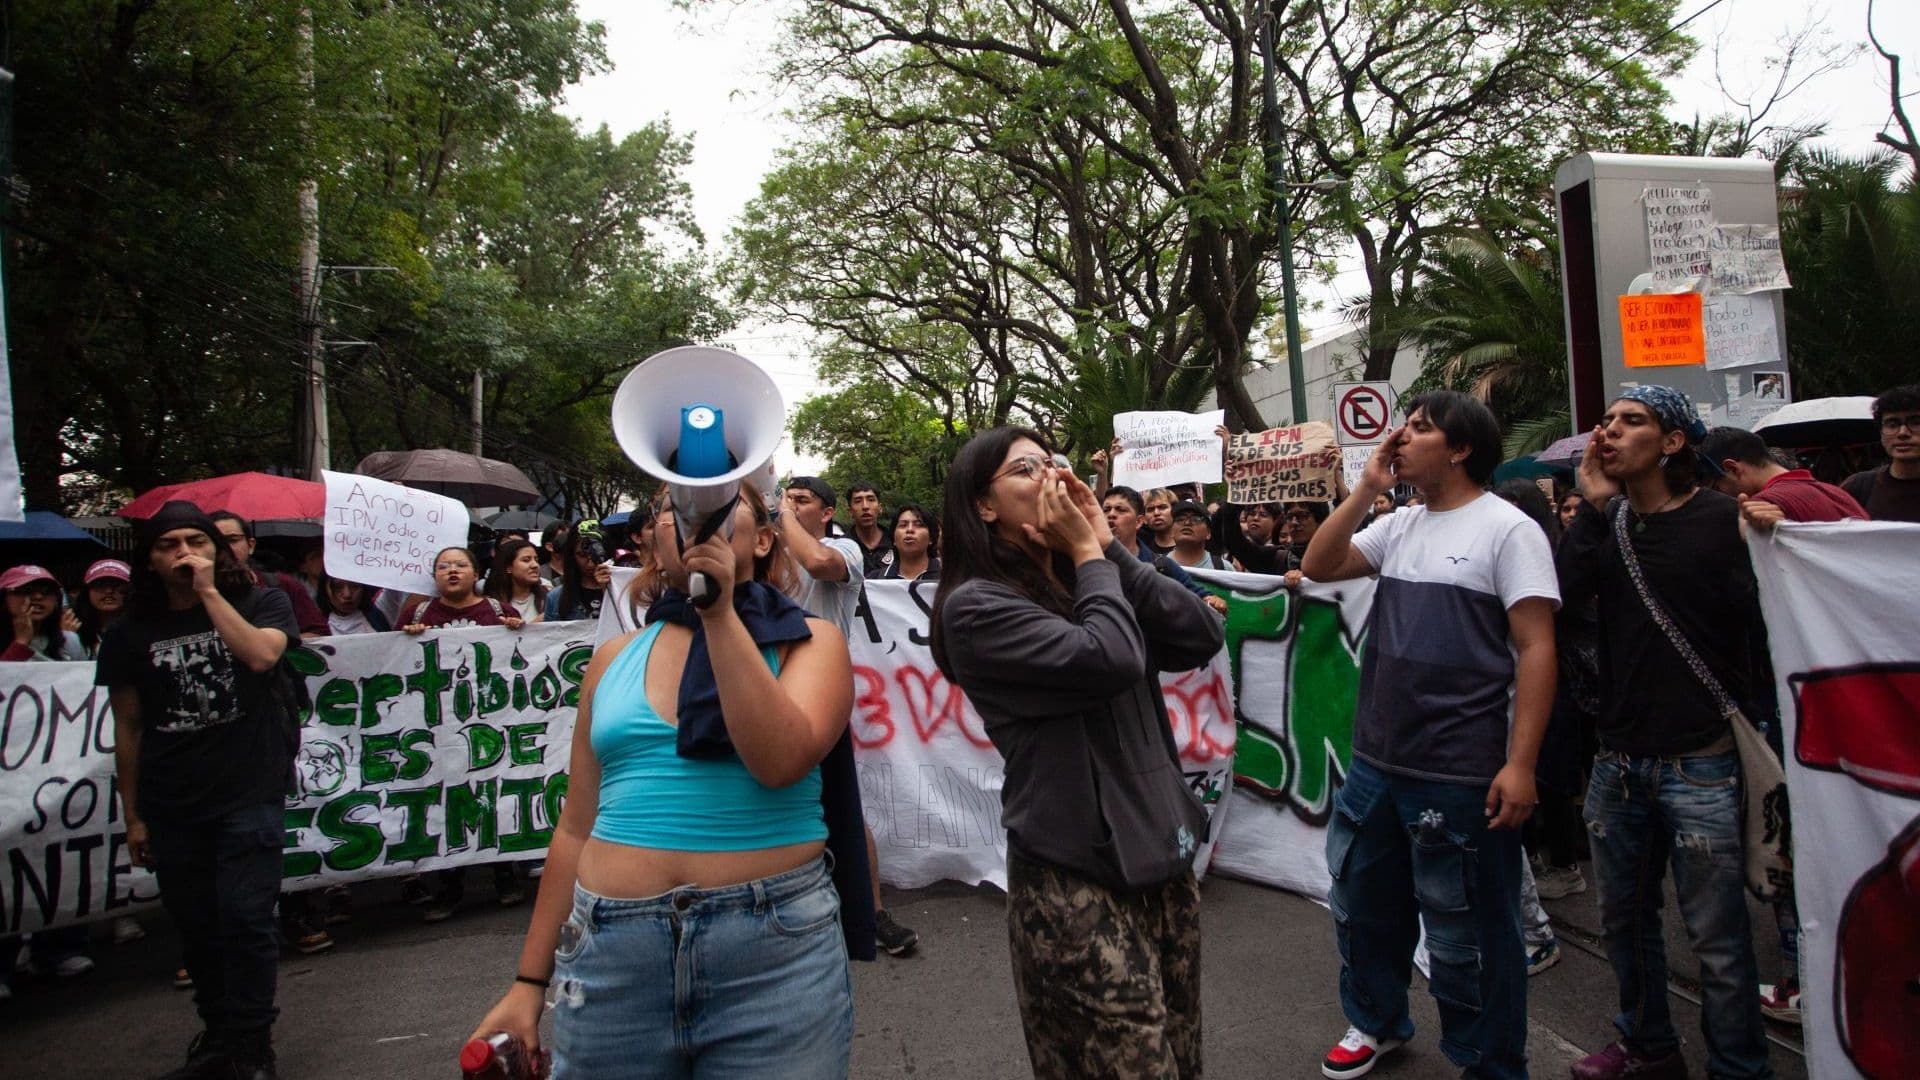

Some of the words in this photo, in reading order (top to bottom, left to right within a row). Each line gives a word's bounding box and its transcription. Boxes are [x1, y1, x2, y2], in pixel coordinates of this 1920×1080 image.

[1703, 299, 1737, 322] Todo
[1230, 434, 1255, 449] EL
[1258, 426, 1302, 446] IPN
[1247, 445, 1265, 460] DE
[1270, 441, 1304, 457] SUS
[1230, 479, 1248, 490] NO
[1250, 475, 1267, 488] DE
[1271, 468, 1301, 484] SUS
[1231, 479, 1332, 503] DIRECTORES.
[346, 482, 415, 518] Amo
[426, 503, 445, 525] al
[333, 530, 401, 554] quienes
[407, 541, 421, 558] lo
[387, 522, 420, 540] odio
[425, 533, 435, 544] a
[353, 550, 422, 577] destruyen
[360, 728, 434, 785] ES
[458, 722, 549, 774] DE
